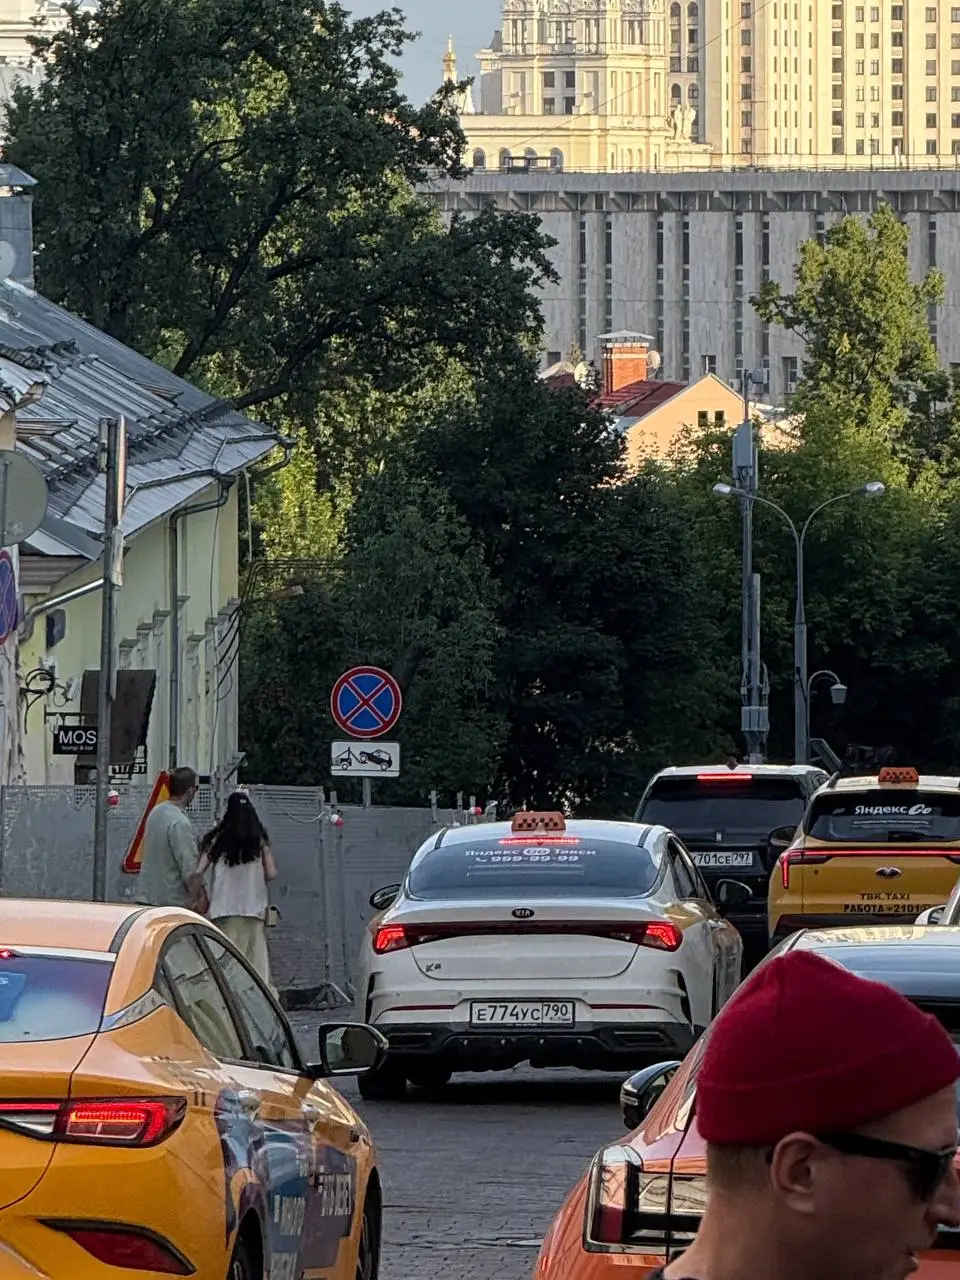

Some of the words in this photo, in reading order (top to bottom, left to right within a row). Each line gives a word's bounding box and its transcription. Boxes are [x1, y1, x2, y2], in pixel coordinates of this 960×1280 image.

[58, 730, 97, 744] MOS
[854, 805, 908, 815] Яндекс
[843, 903, 885, 913] РАБОТА
